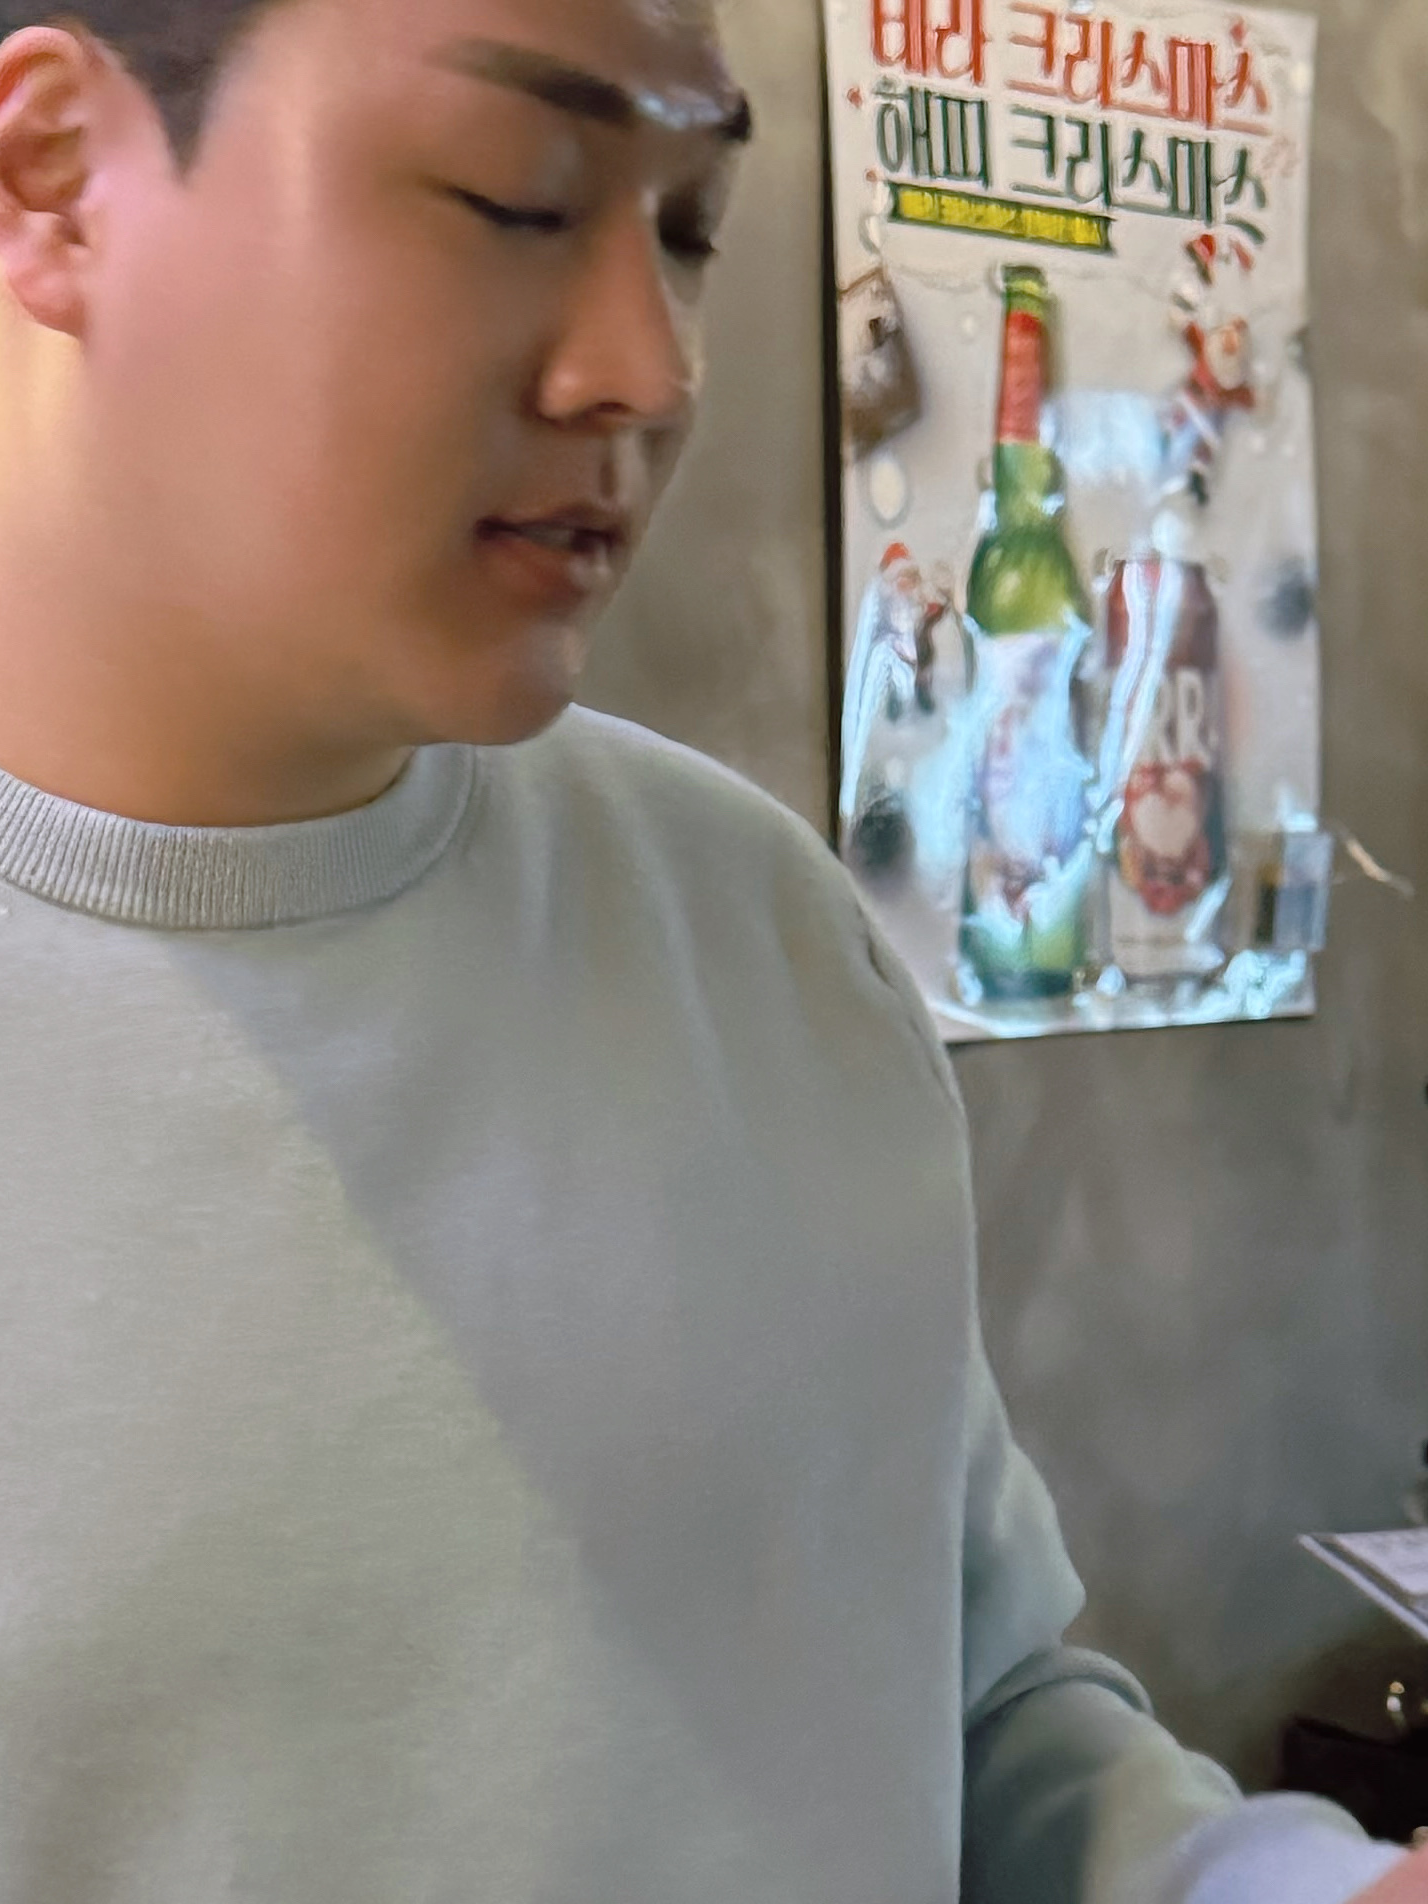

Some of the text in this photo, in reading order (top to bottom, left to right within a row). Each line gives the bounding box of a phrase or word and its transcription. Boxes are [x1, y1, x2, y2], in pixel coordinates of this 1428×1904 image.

[1005, 0, 1271, 138] 크리스마스
[872, 74, 989, 189] 해피
[1007, 103, 1269, 244] 크리스마스
